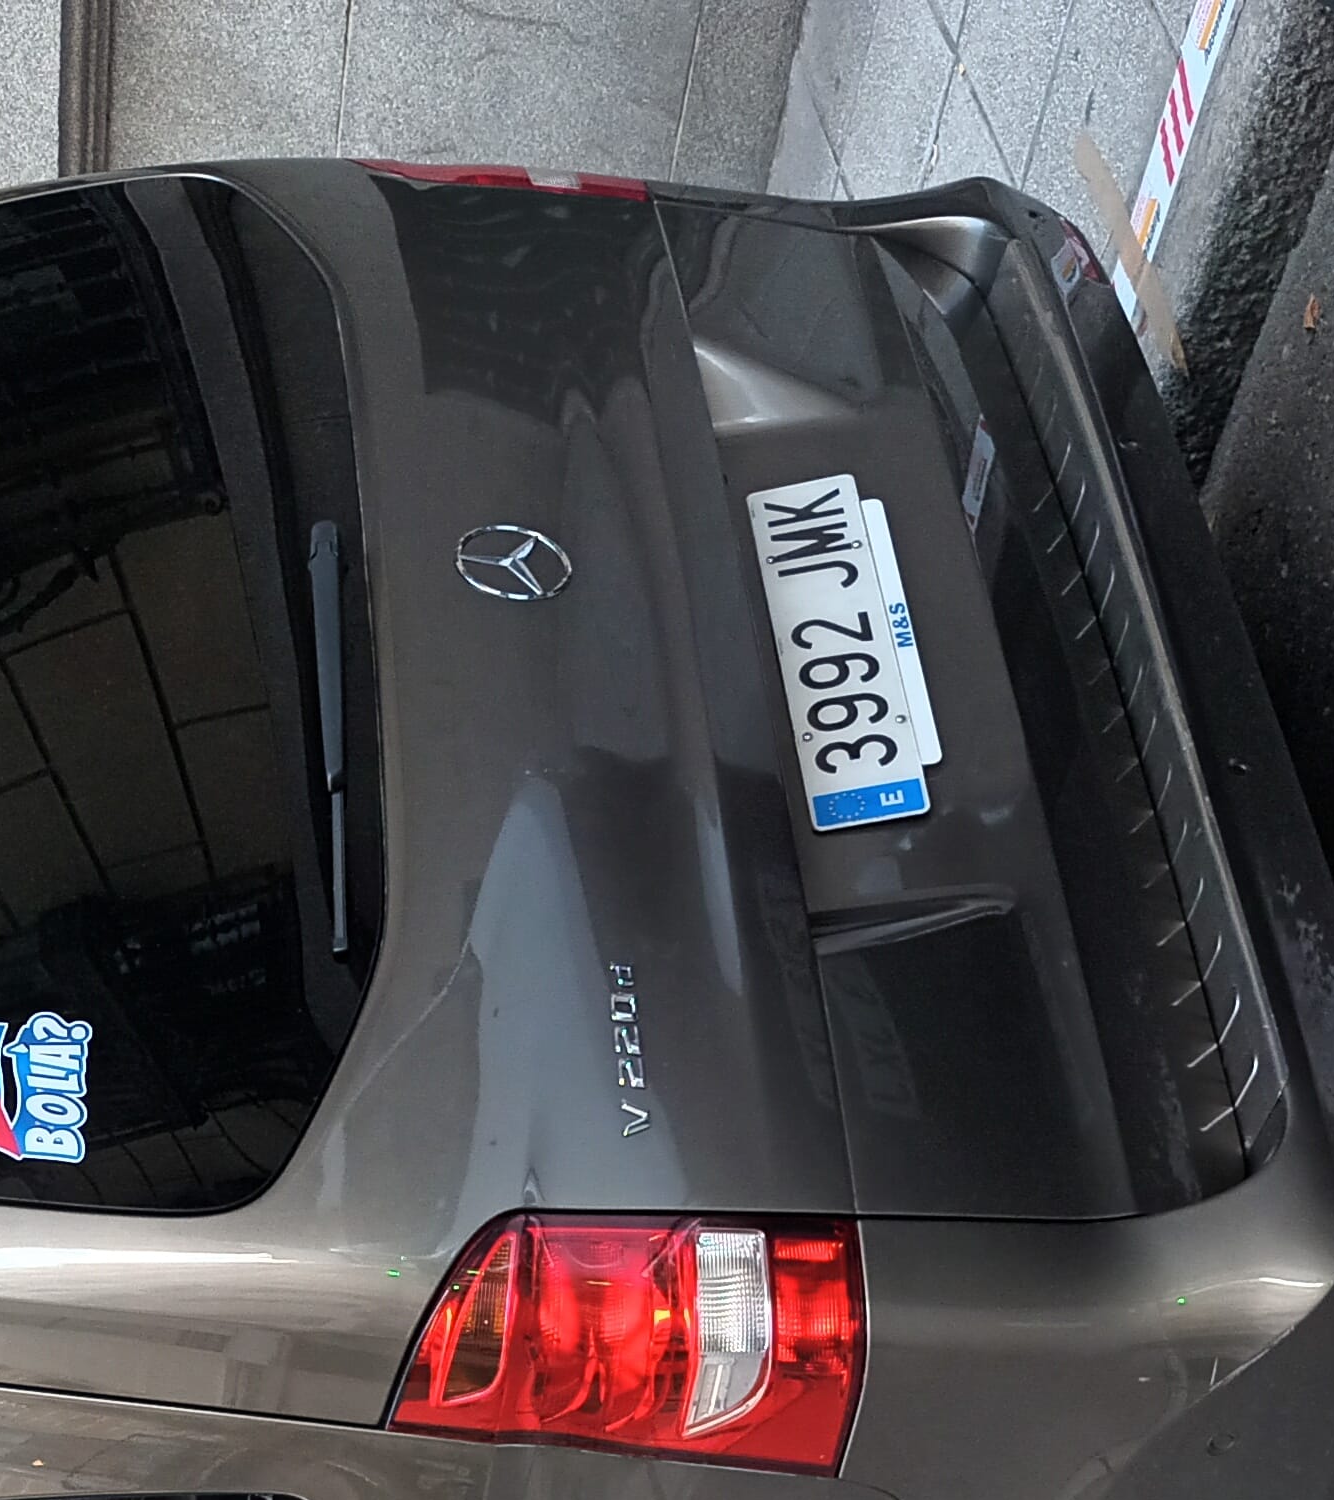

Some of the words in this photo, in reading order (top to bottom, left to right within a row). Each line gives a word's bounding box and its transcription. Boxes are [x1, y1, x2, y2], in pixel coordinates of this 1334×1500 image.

[763, 488, 859, 589] JMK
[888, 602, 914, 649] M&S
[790, 611, 898, 775] 3992
[879, 790, 905, 807] E
[7, 1014, 89, 1159] BOLÁ?
[620, 1102, 651, 1137] V
